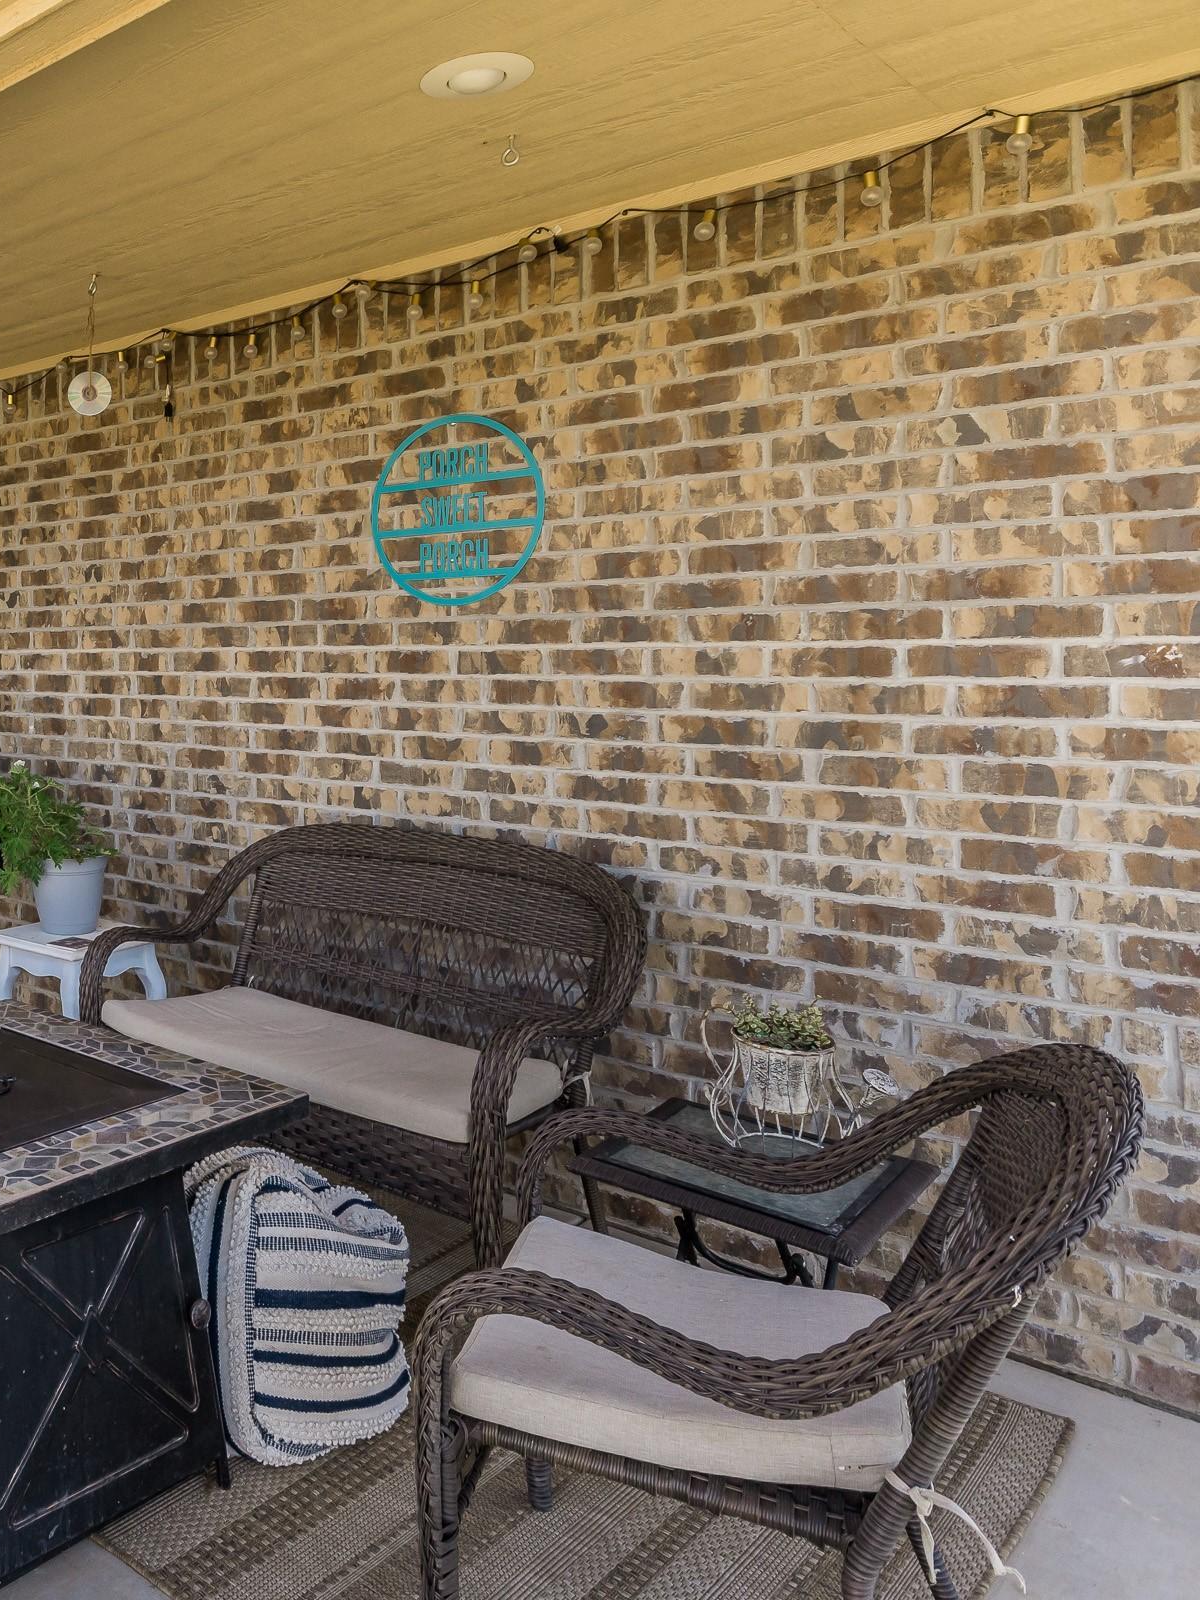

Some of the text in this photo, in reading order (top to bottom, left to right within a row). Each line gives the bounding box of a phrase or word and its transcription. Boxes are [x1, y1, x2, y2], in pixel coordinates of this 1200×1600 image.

[418, 443, 489, 481] PORCH
[420, 491, 488, 528] SWEET
[419, 538, 490, 574] PORCH
